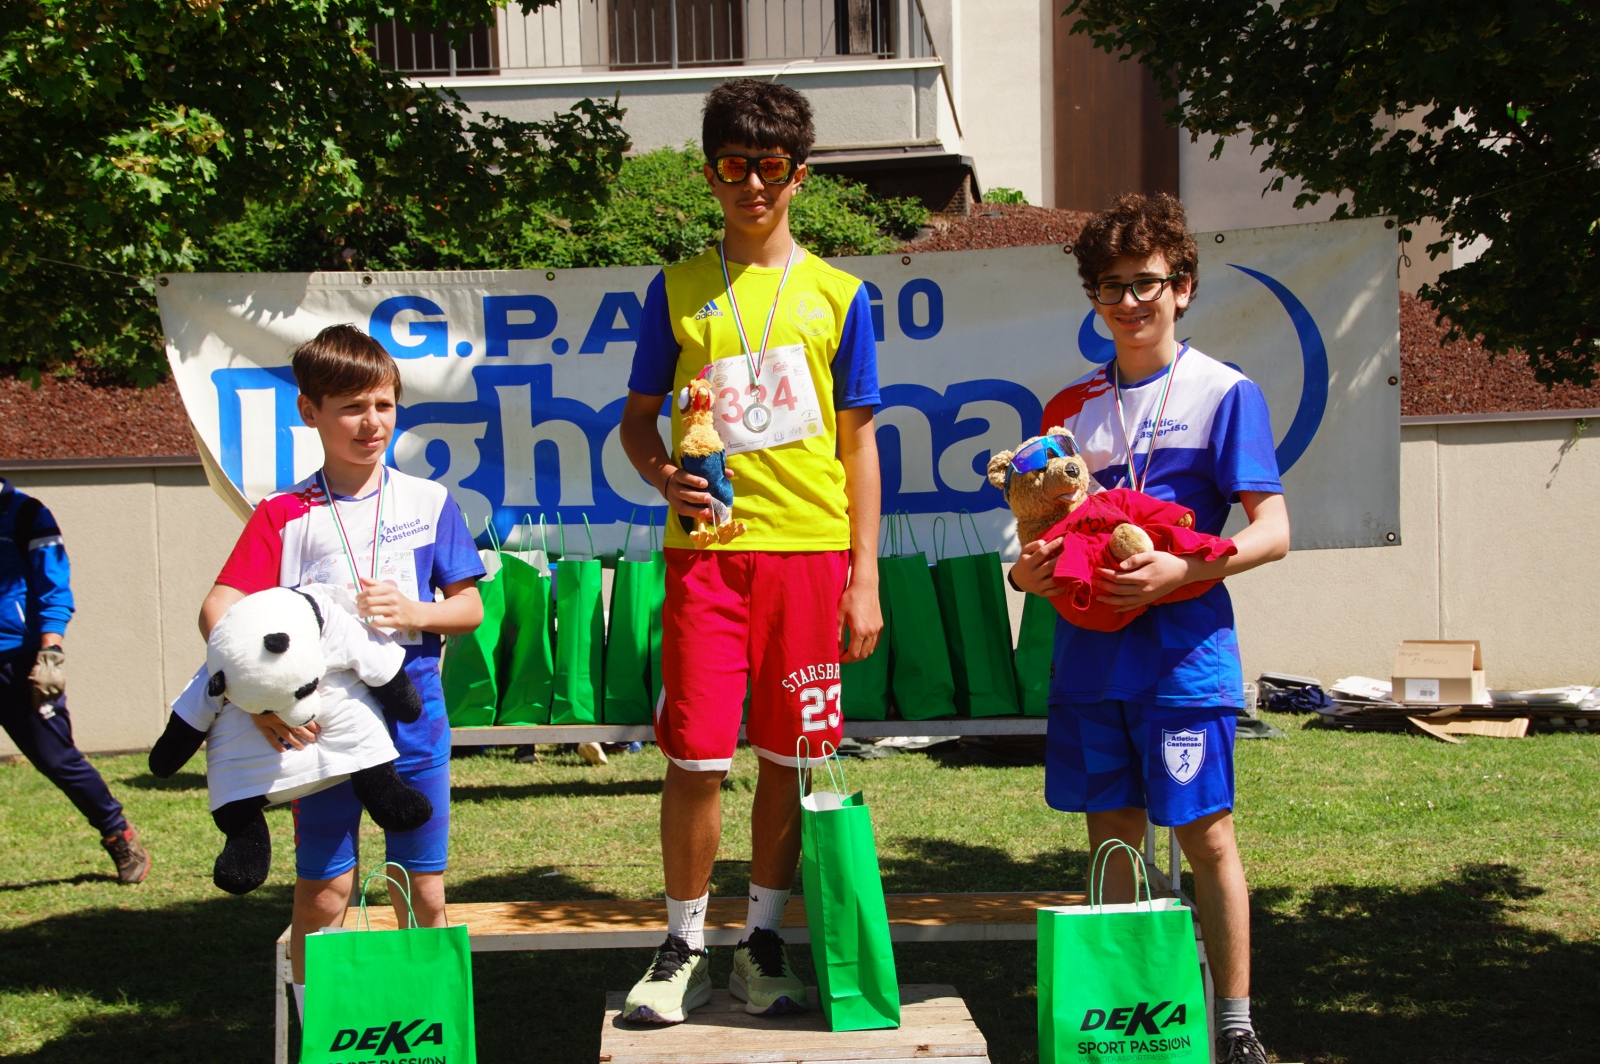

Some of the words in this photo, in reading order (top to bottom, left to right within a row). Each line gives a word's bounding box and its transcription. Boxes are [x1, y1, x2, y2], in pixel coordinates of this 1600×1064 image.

[695, 310, 724, 321] adidas
[385, 524, 430, 543] Castenaso
[386, 518, 421, 535] Atletica
[800, 683, 841, 732] 23
[1080, 1001, 1187, 1036] DEKA
[329, 1018, 443, 1056] DEKA
[1078, 1041, 1126, 1055] SPORT
[1130, 1035, 1191, 1054] PASSION
